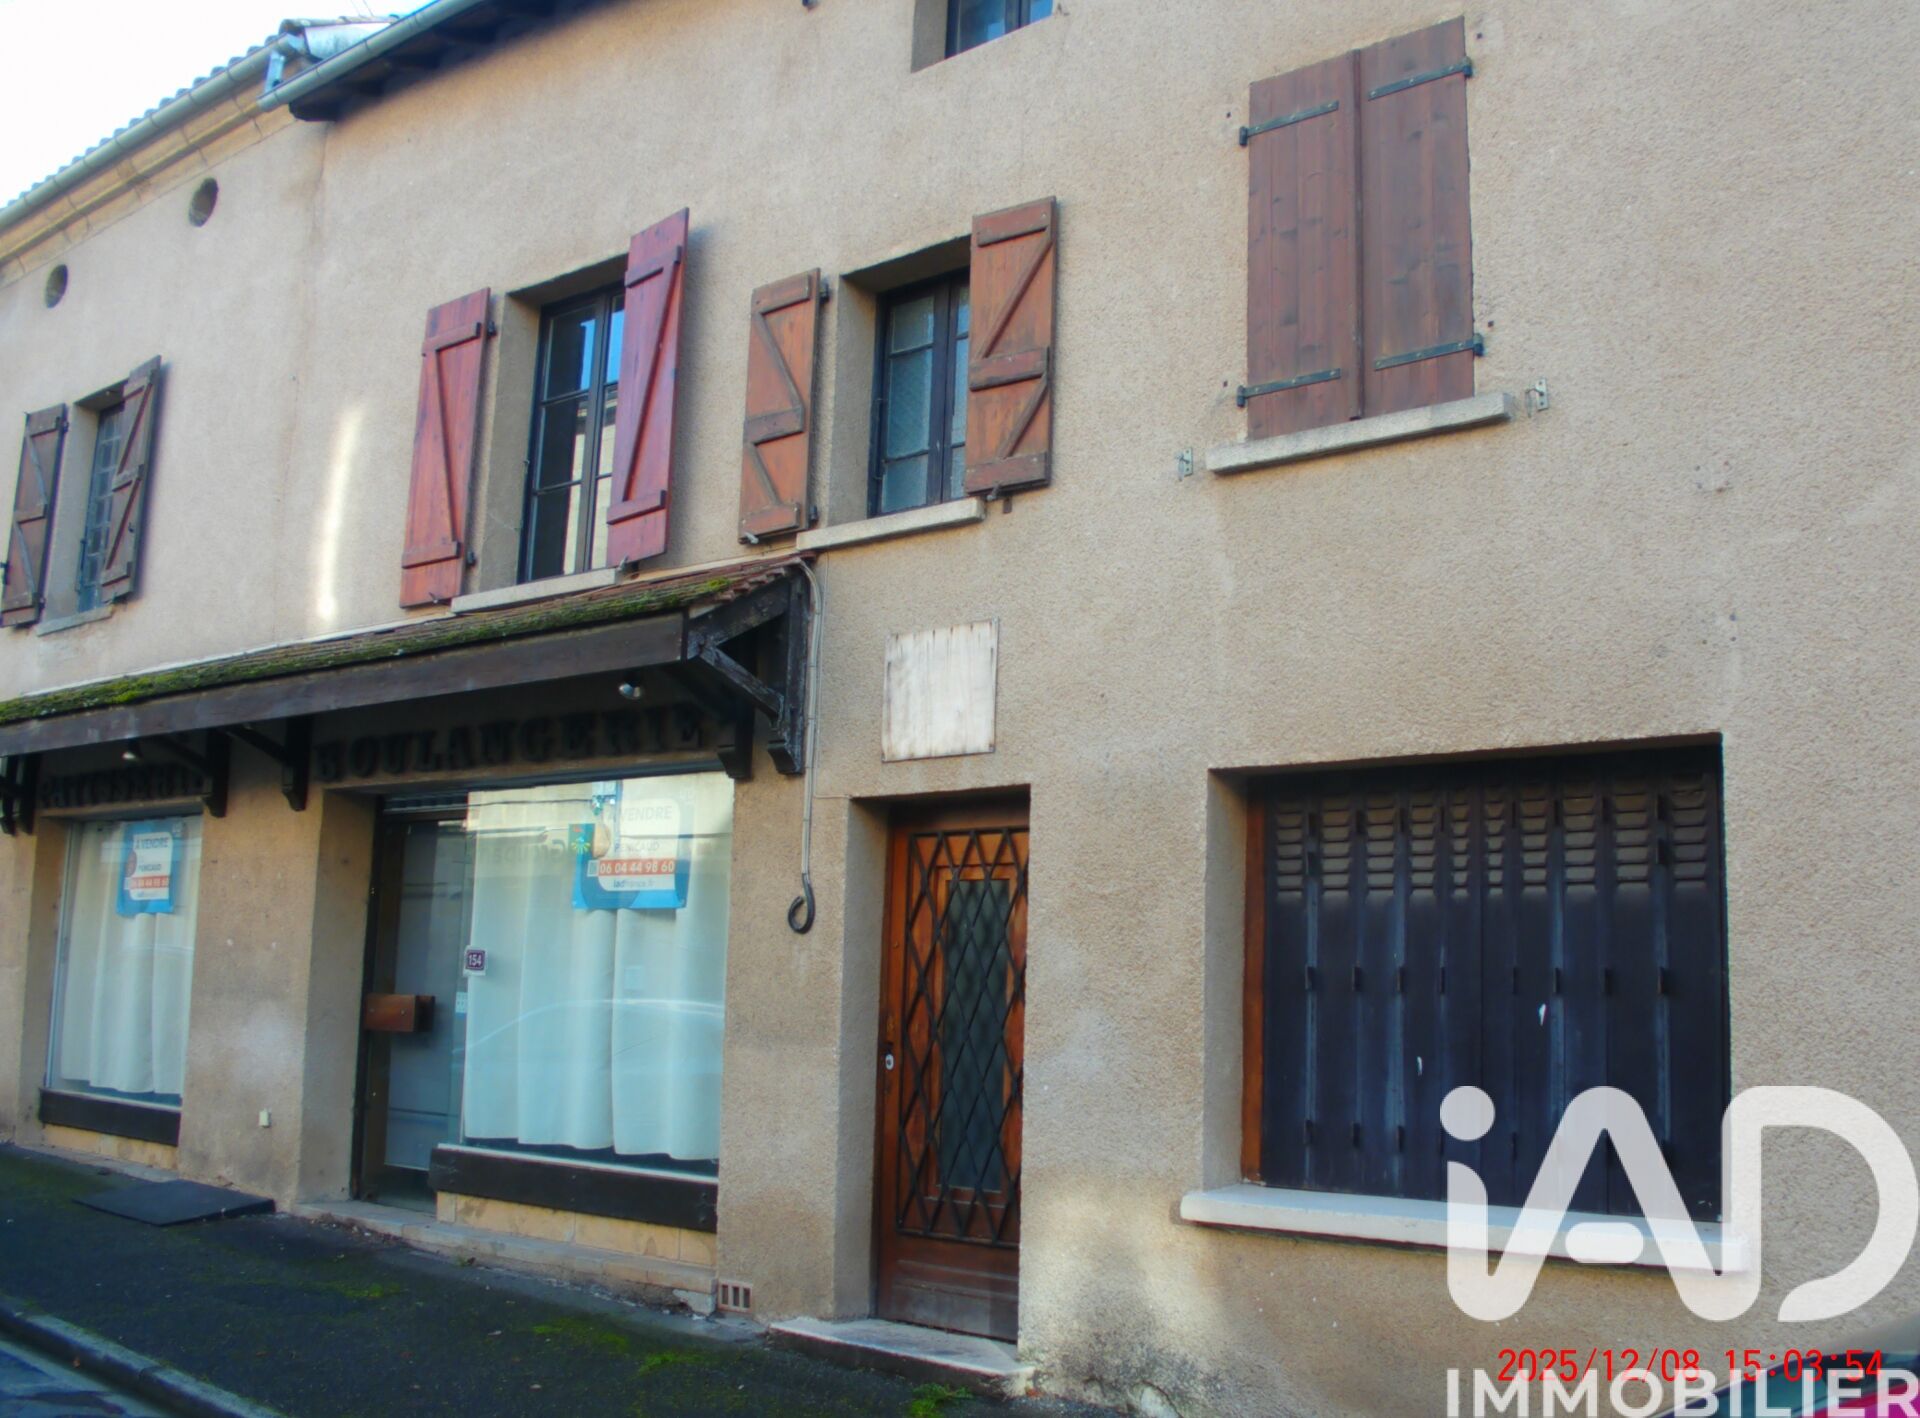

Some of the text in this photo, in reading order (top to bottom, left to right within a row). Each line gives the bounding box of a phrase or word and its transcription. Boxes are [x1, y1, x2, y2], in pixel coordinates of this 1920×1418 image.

[313, 702, 703, 781] BOULANGERIE
[620, 805, 673, 822] VENDRE
[600, 860, 674, 874] 06 04 44 98 60
[469, 954, 482, 966] 154
